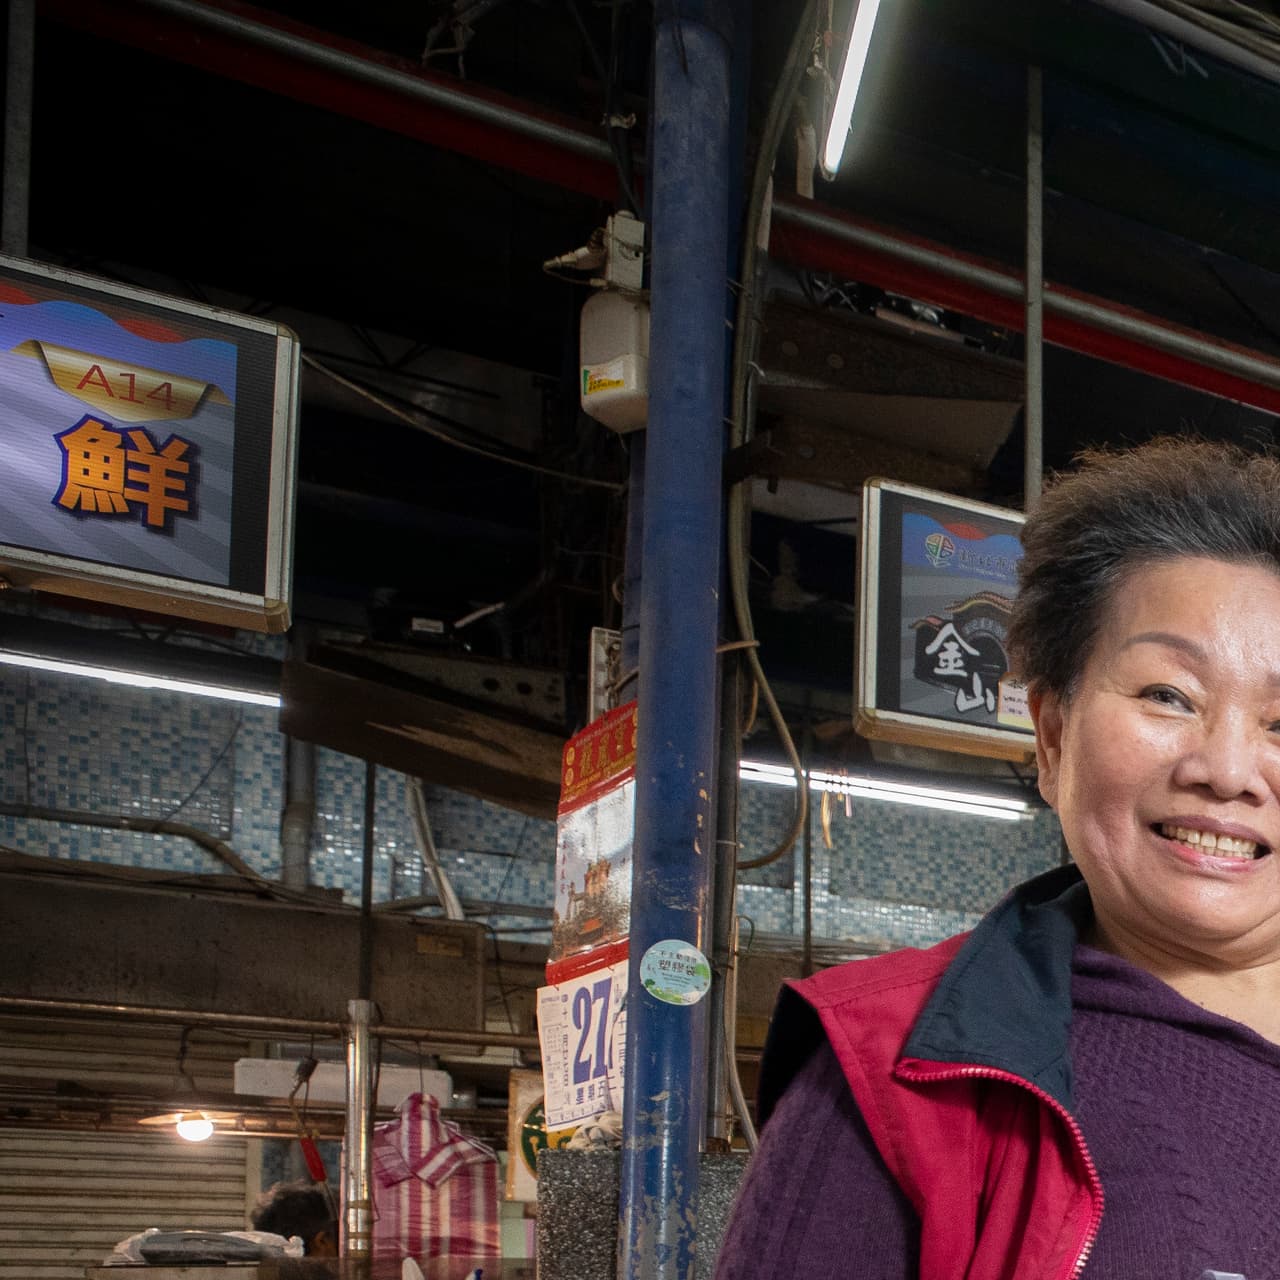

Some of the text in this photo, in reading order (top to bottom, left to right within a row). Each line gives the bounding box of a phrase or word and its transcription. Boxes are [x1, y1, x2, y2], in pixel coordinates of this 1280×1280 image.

[76, 364, 177, 410] A14
[56, 416, 192, 528] 鮮
[924, 622, 996, 713] 金山
[572, 977, 612, 1085] 27
